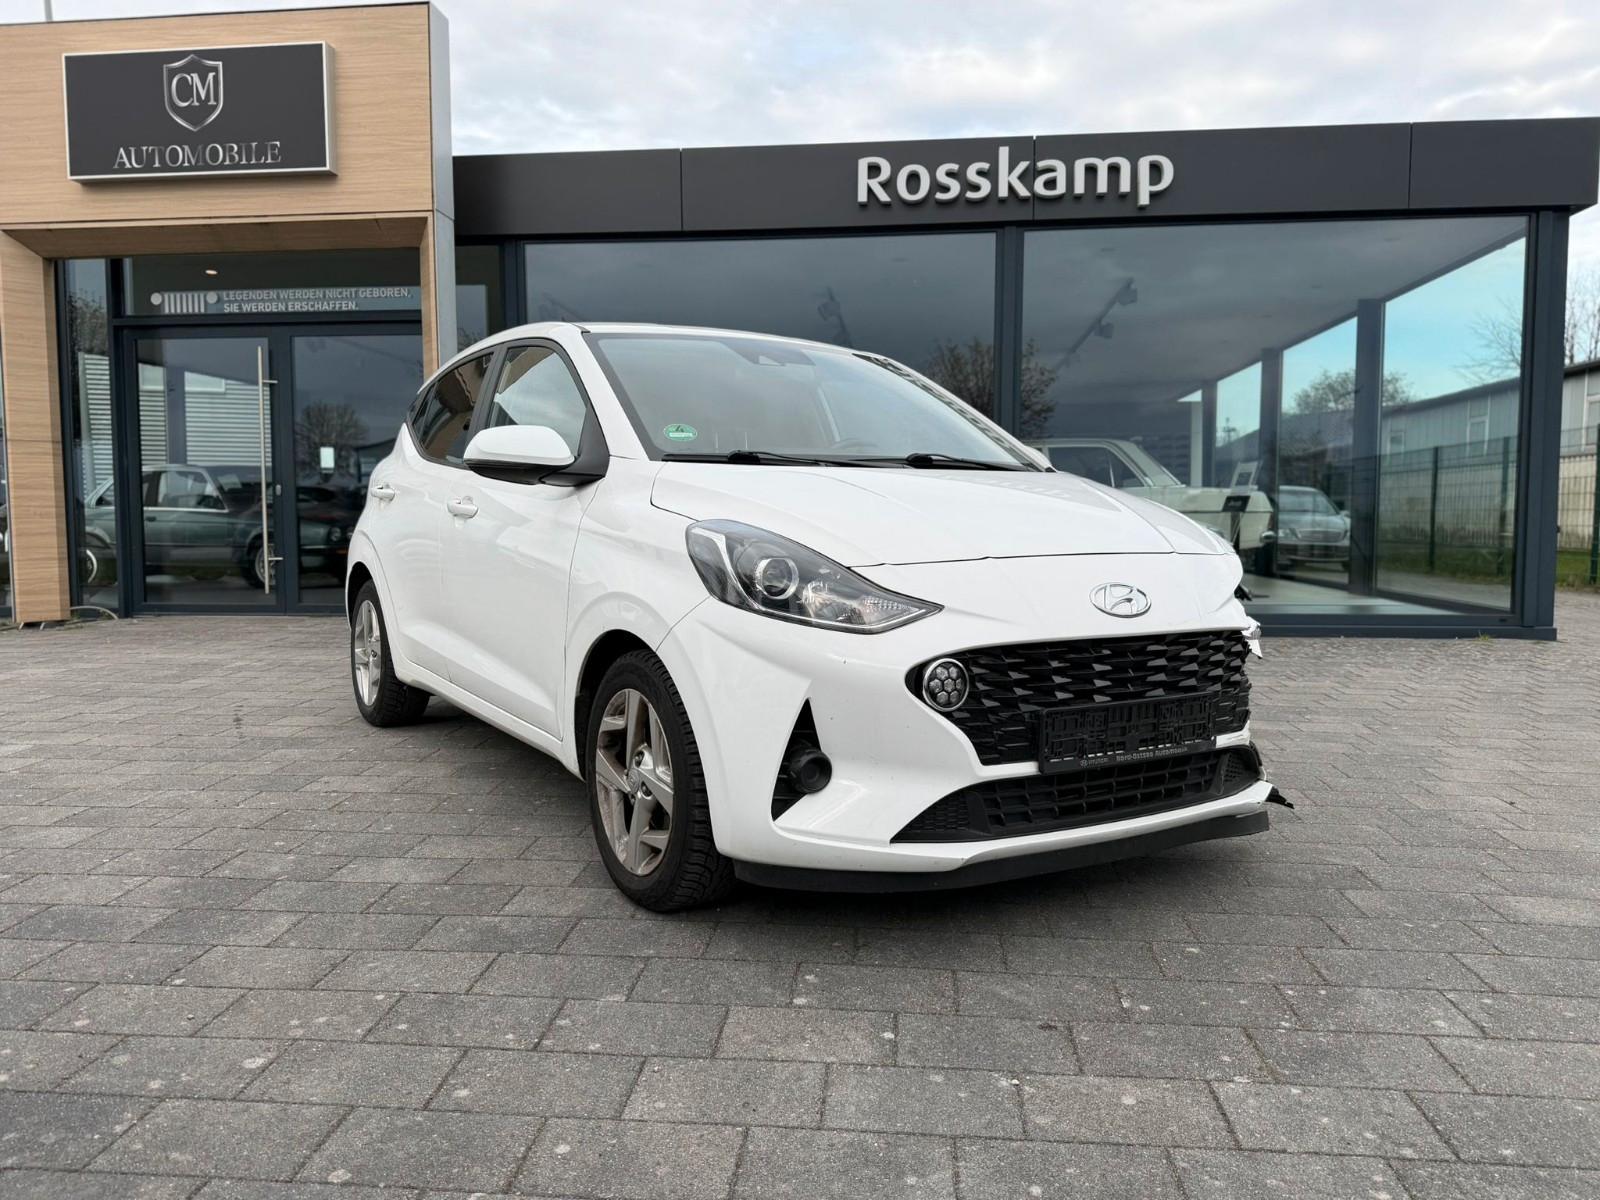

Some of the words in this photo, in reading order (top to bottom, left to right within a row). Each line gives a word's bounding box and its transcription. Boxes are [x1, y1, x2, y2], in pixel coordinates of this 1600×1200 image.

[170, 73, 217, 107] CM
[113, 141, 281, 169] AUTOMOBILE
[857, 146, 1175, 207] Rosskamp
[223, 289, 275, 301] LEGENDEN
[279, 289, 323, 300] WERDEN
[326, 288, 357, 299] NICHT
[223, 303, 239, 313] SIE
[242, 302, 285, 313] WERDEN
[288, 300, 359, 312] ERSCHAFFEN.
